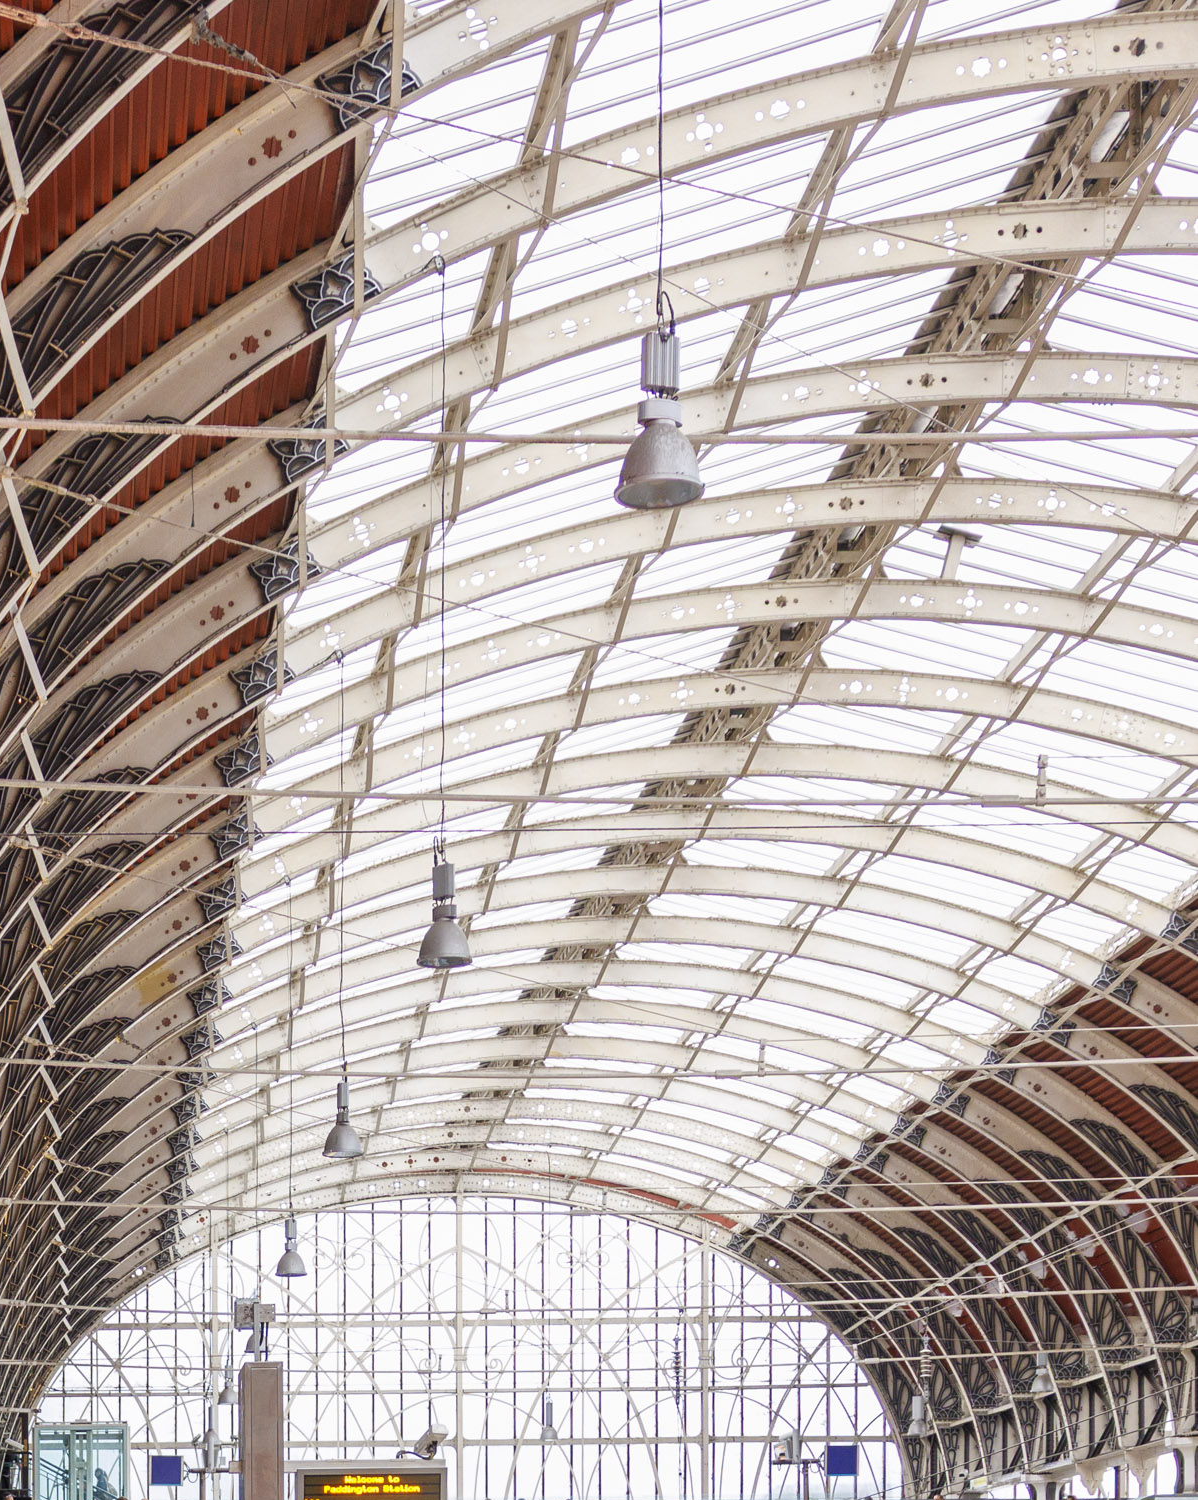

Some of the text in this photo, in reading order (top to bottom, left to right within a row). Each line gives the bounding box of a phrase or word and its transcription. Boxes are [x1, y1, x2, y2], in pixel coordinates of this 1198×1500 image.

[344, 1475, 400, 1484] Welcome to
[324, 1484, 420, 1494] Paddington Station
